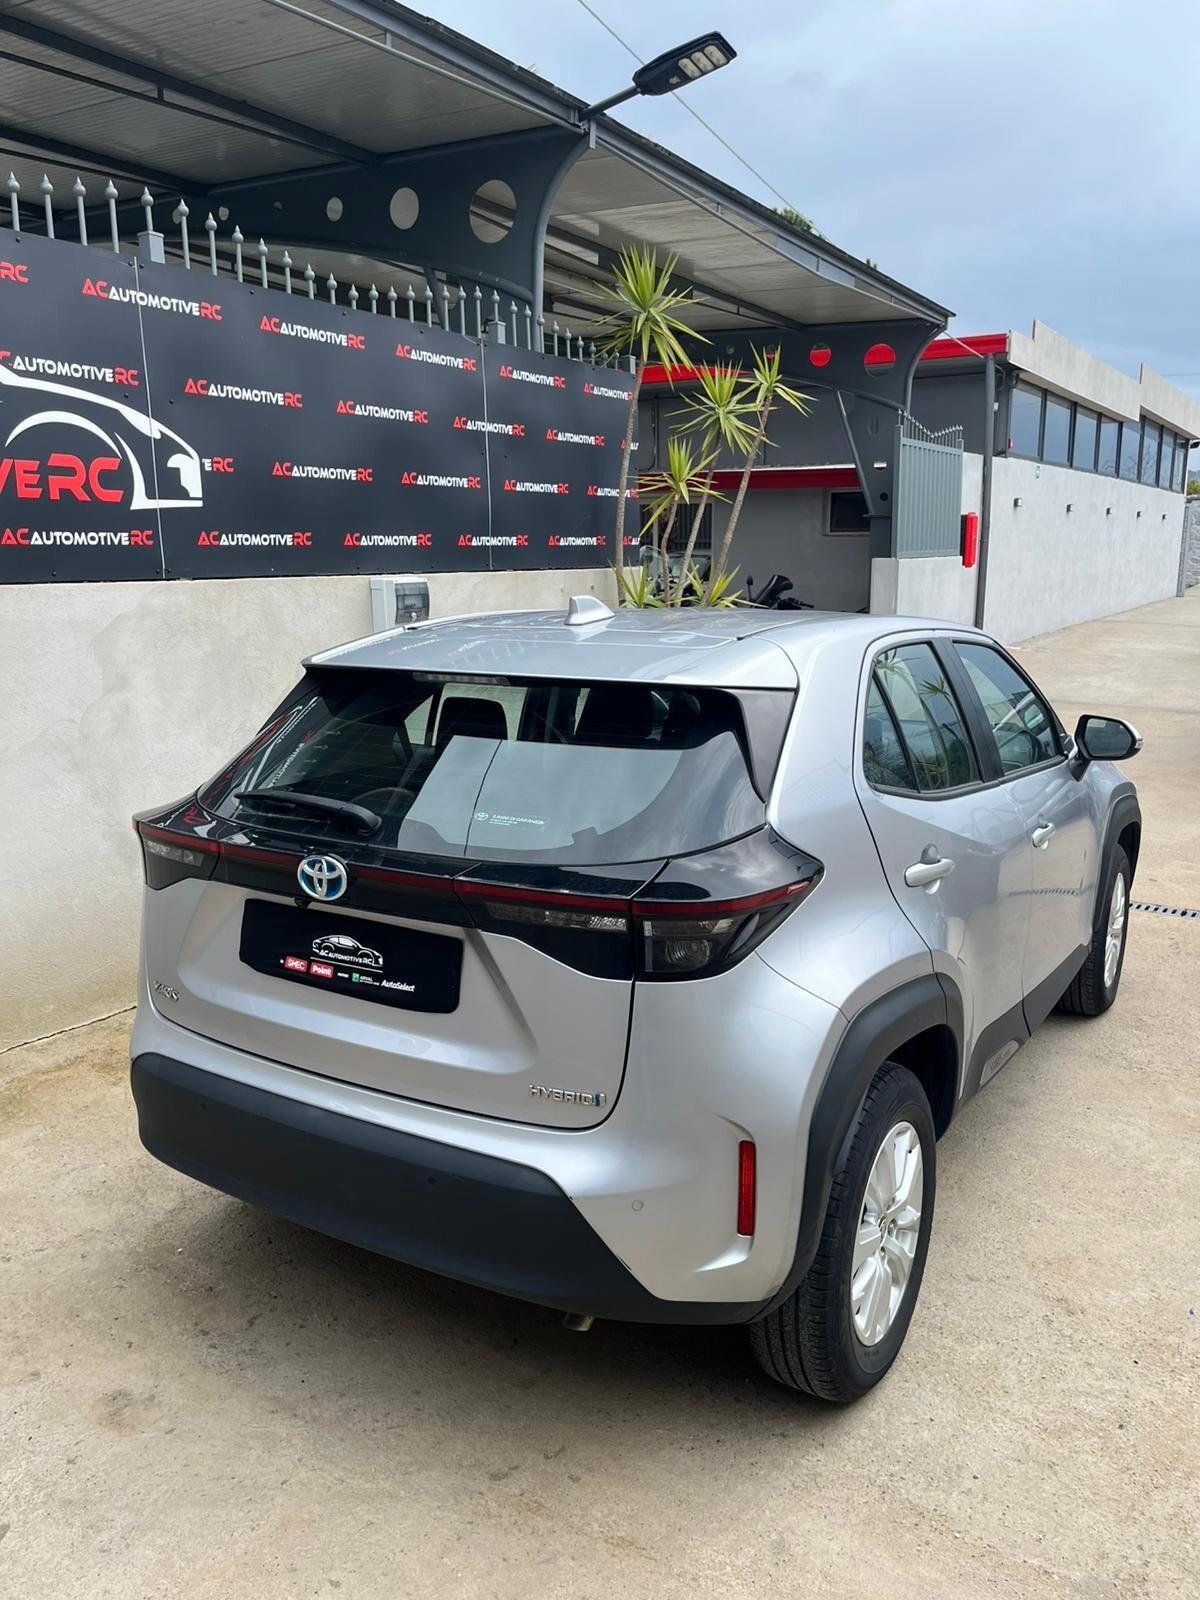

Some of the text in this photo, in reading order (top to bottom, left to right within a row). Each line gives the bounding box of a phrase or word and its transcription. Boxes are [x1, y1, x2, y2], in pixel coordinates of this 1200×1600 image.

[202, 457, 235, 473] ERC
[312, 964, 333, 976] Point
[529, 1083, 593, 1106] HYBRID
